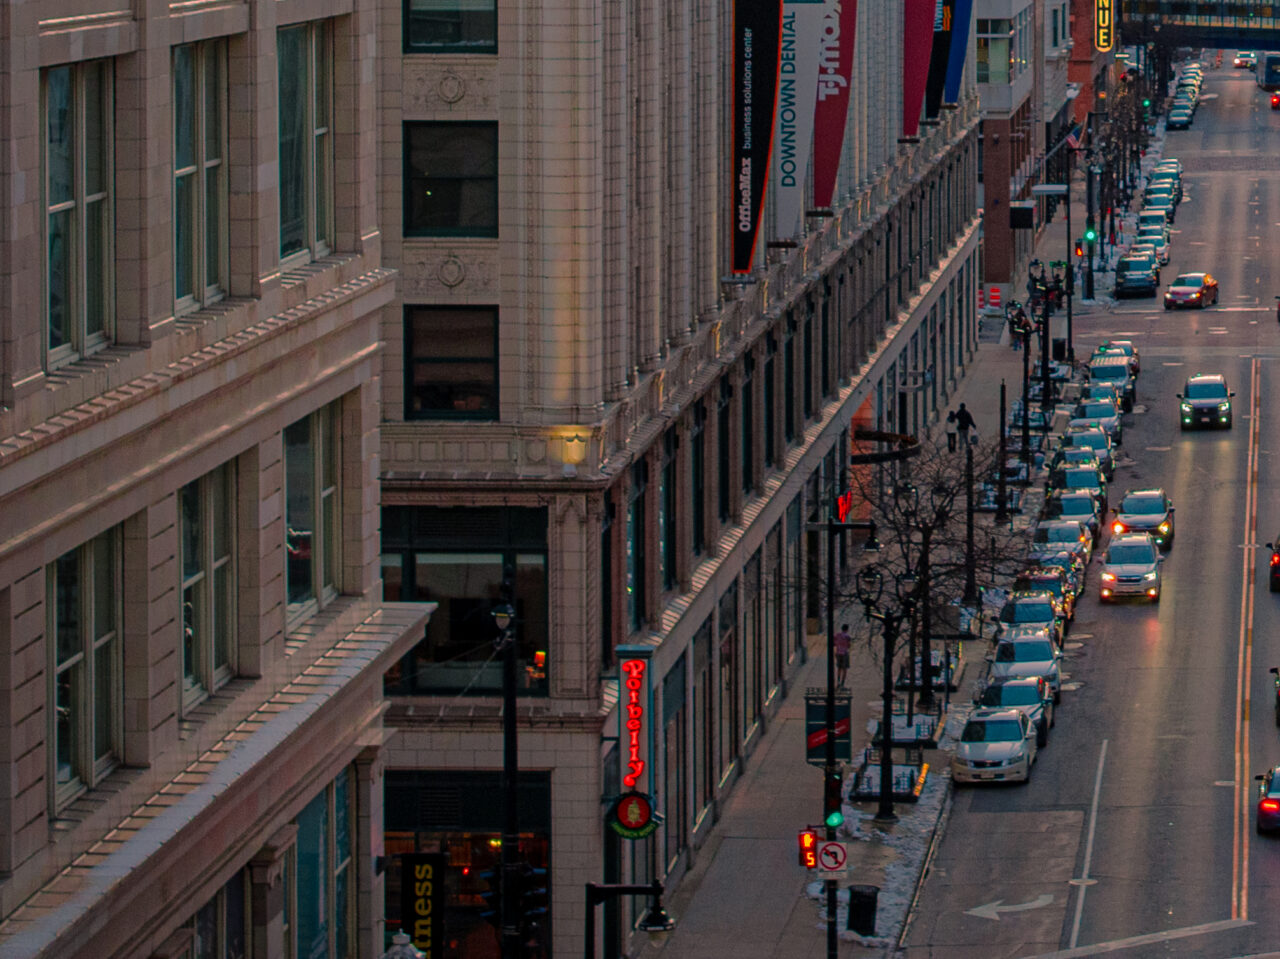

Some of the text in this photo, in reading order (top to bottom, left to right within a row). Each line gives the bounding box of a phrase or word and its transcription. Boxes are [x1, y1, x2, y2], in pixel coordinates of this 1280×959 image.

[738, 27, 753, 232] OfficeMax business solutions center
[780, 11, 797, 187] DOWNTOWN DENTAL
[622, 659, 646, 787] Potbelly
[806, 852, 815, 866] 5
